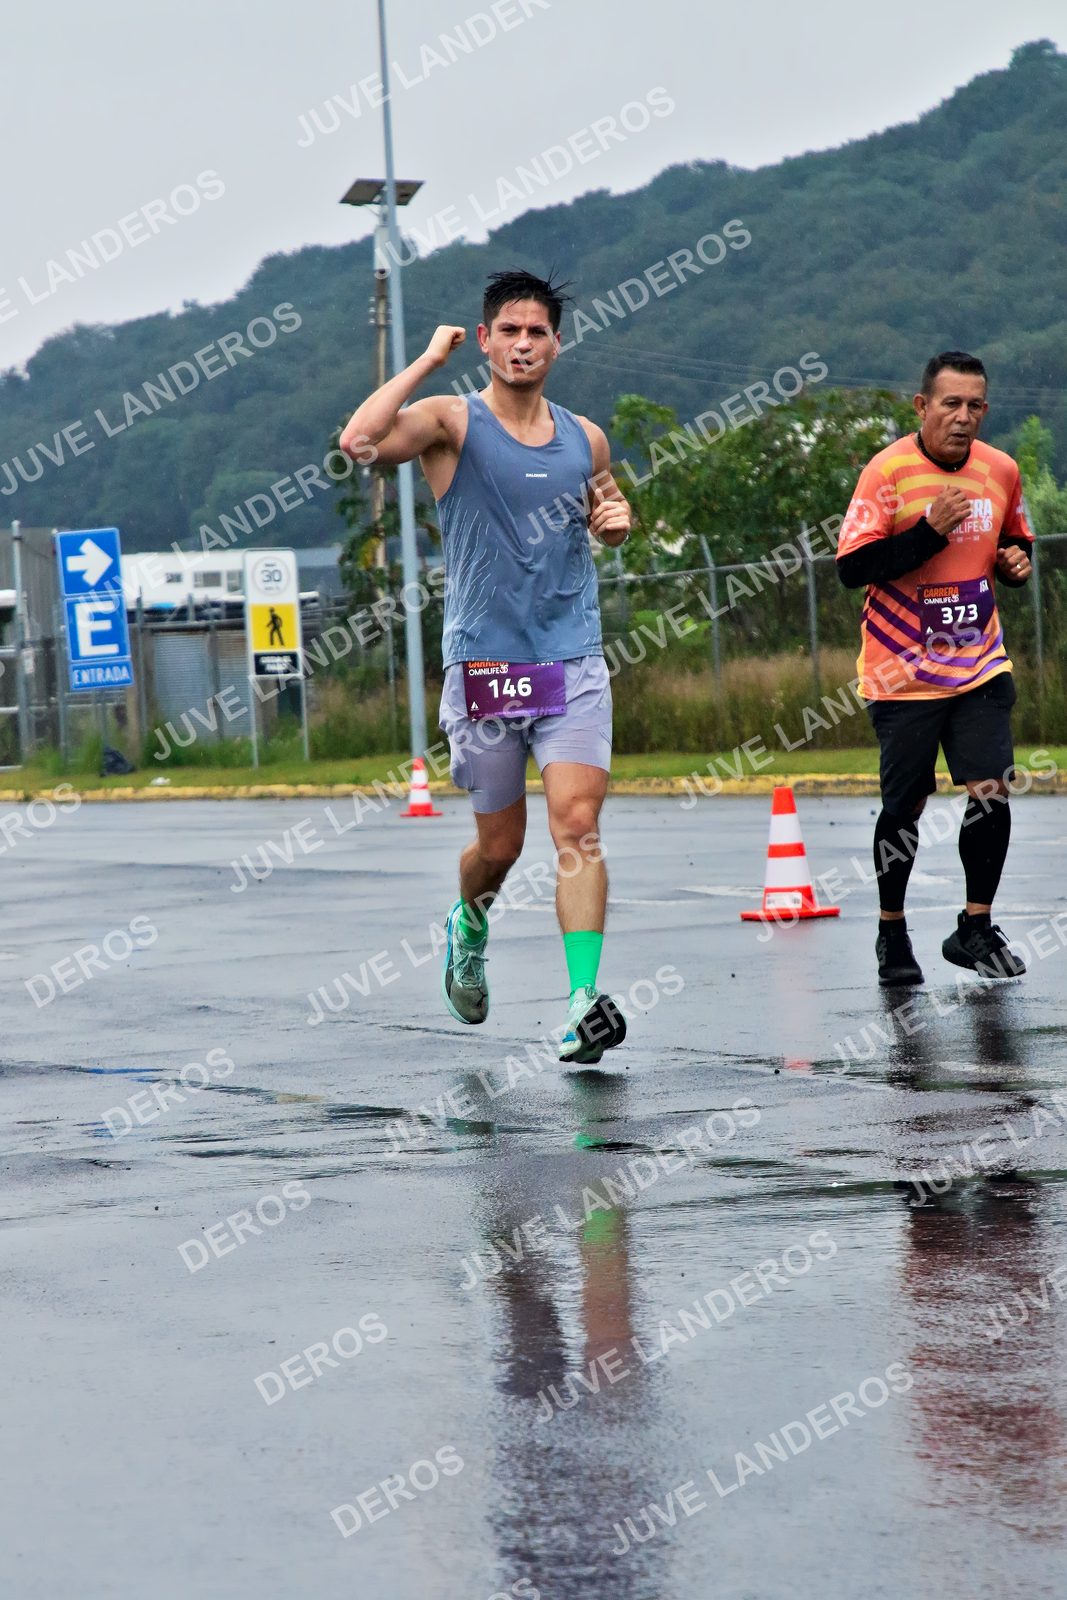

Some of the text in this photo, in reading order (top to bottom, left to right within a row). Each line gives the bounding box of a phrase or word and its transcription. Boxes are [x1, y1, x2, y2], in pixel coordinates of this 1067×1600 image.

[261, 569, 282, 582] 30
[924, 586, 959, 598] CARRERA
[941, 604, 978, 624] 373
[75, 601, 119, 657] E
[72, 666, 130, 684] ENTRADA
[488, 677, 532, 698] 146
